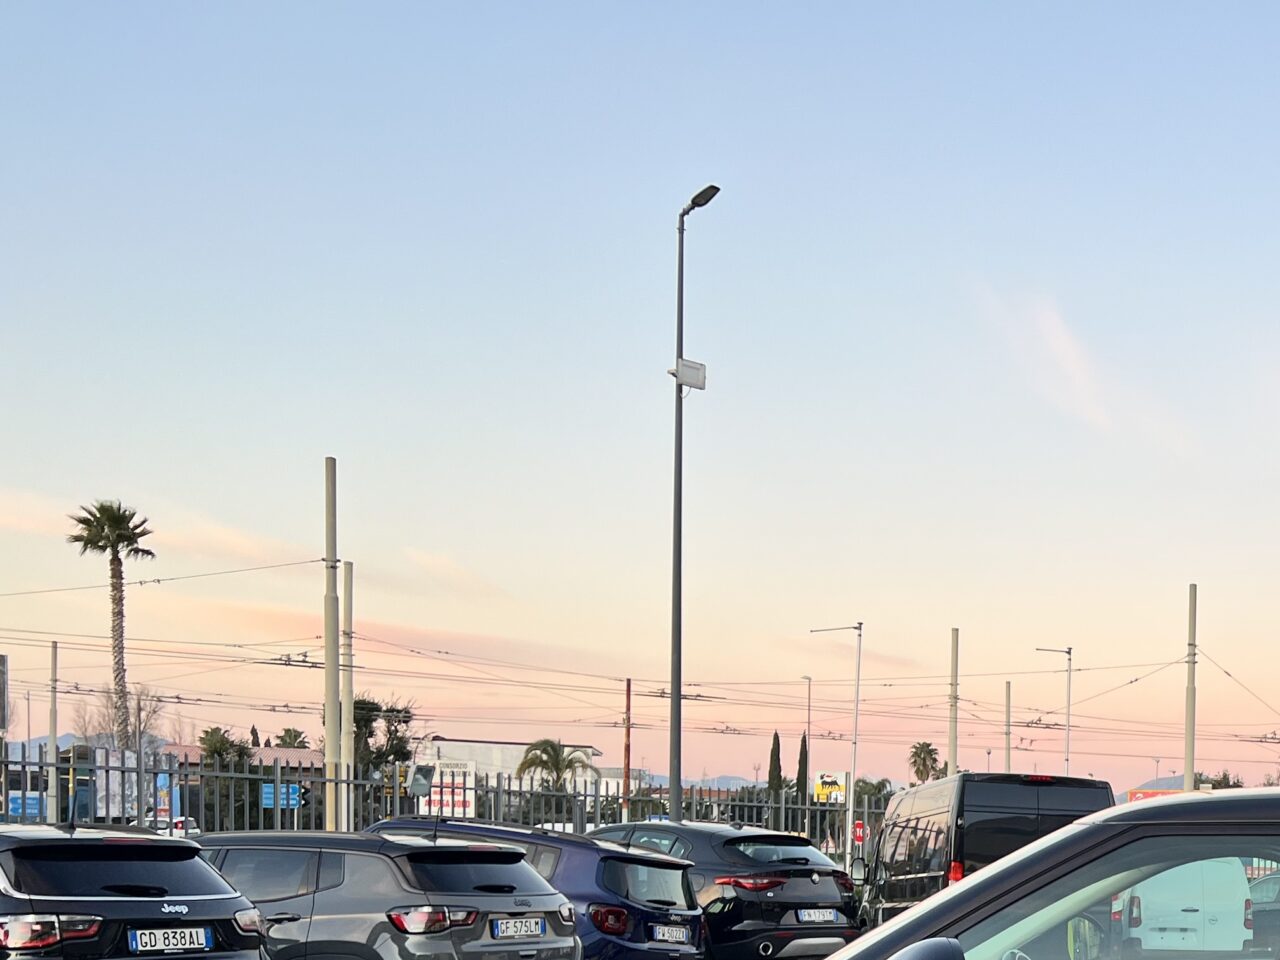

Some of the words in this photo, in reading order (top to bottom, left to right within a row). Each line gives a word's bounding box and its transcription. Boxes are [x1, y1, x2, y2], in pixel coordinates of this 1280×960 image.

[161, 903, 189, 915] Jeep
[513, 920, 539, 934] 575LM
[139, 931, 157, 948] GD
[163, 930, 204, 948] 838AL
